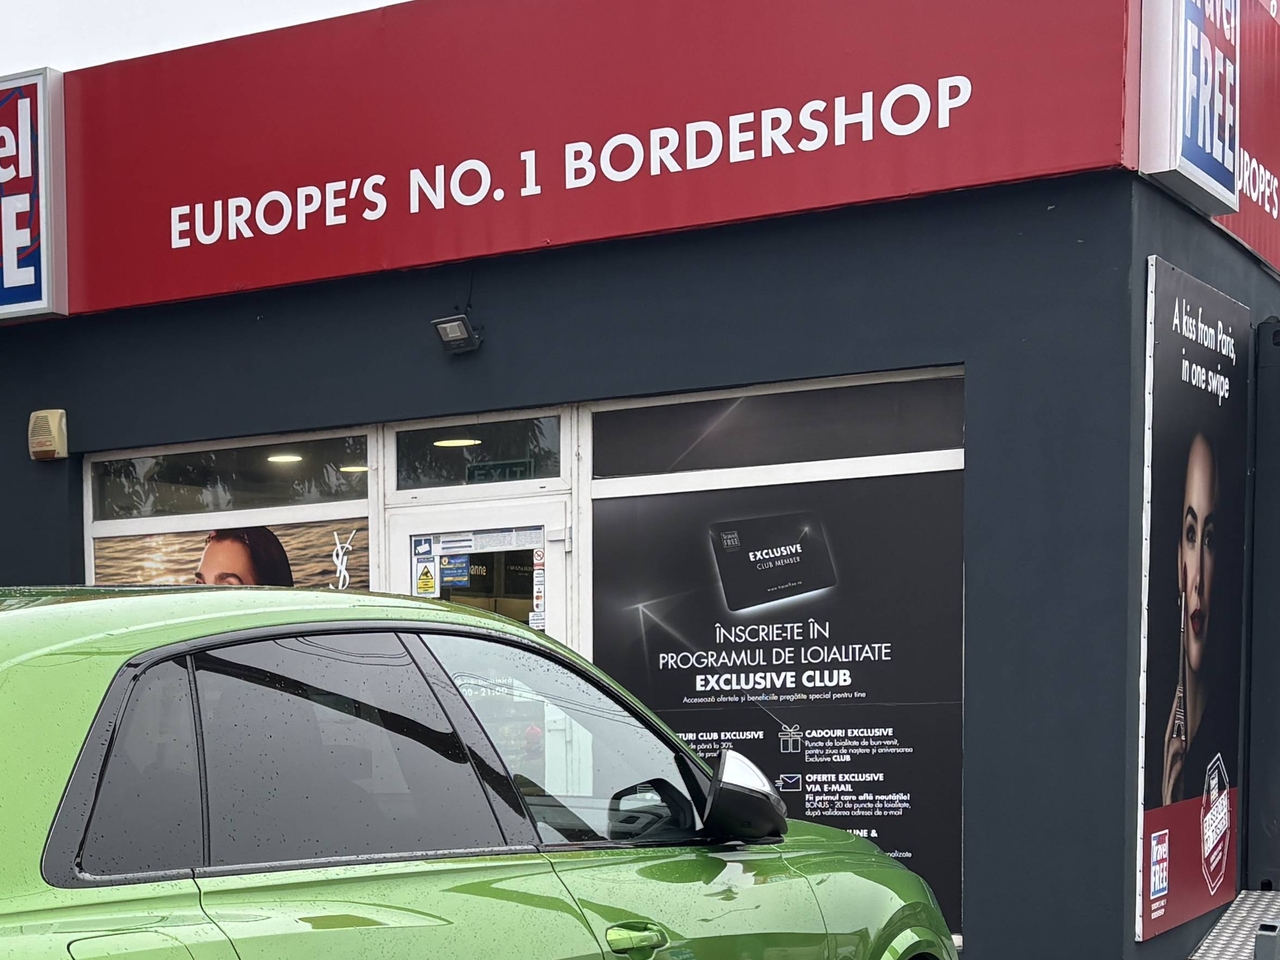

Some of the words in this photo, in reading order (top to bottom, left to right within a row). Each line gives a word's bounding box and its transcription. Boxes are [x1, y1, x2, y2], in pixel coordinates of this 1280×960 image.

[1185, 19, 1235, 174] FREE
[170, 174, 387, 249] EUROPE'S
[410, 159, 505, 214] NO.
[520, 149, 542, 197] 1
[565, 75, 972, 189] BORDERSHOP
[1172, 297, 1181, 334] A
[1182, 299, 1197, 341] kiss
[1197, 307, 1216, 350] from
[1217, 320, 1237, 366] Paris,
[1181, 347, 1190, 382] in
[1191, 363, 1207, 390] one
[1207, 363, 1231, 406] swipe
[474, 467, 525, 483] EXIT
[748, 543, 803, 562] EXCLUSIVE
[756, 559, 774, 571] CLUB
[775, 556, 801, 567] MEMBER
[714, 622, 804, 644] ÎNSCRIE-TE
[808, 618, 830, 640] ÎN
[659, 649, 768, 670] PROGRAMUL
[771, 648, 795, 666] DE
[800, 643, 893, 664] LOIALITATE
[695, 671, 797, 692] EXCLUSIVE
[801, 669, 853, 688] CLUB
[716, 694, 739, 703] ofertele
[808, 692, 832, 701] special
[832, 692, 854, 700] pentru
[698, 732, 719, 740] CLUB
[720, 731, 764, 740] EXCLUSIVE
[805, 729, 845, 738] CADOURI
[847, 728, 894, 737] EXCLUSIVE
[805, 739, 824, 747] Puncte
[825, 739, 834, 747] de
[860, 738, 869, 746] de
[805, 755, 832, 763] Exclusive
[832, 754, 851, 762] CLUB
[805, 774, 837, 782] OFERTE
[838, 773, 885, 782] EXCLUSIVE
[805, 784, 821, 792] VIA
[823, 783, 853, 792] E-MAIL
[815, 793, 839, 803] primul
[805, 801, 830, 809] BONUS
[834, 801, 844, 809] 20
[874, 808, 883, 816] de
[870, 829, 879, 838] &
[1151, 861, 1168, 892] FREE
